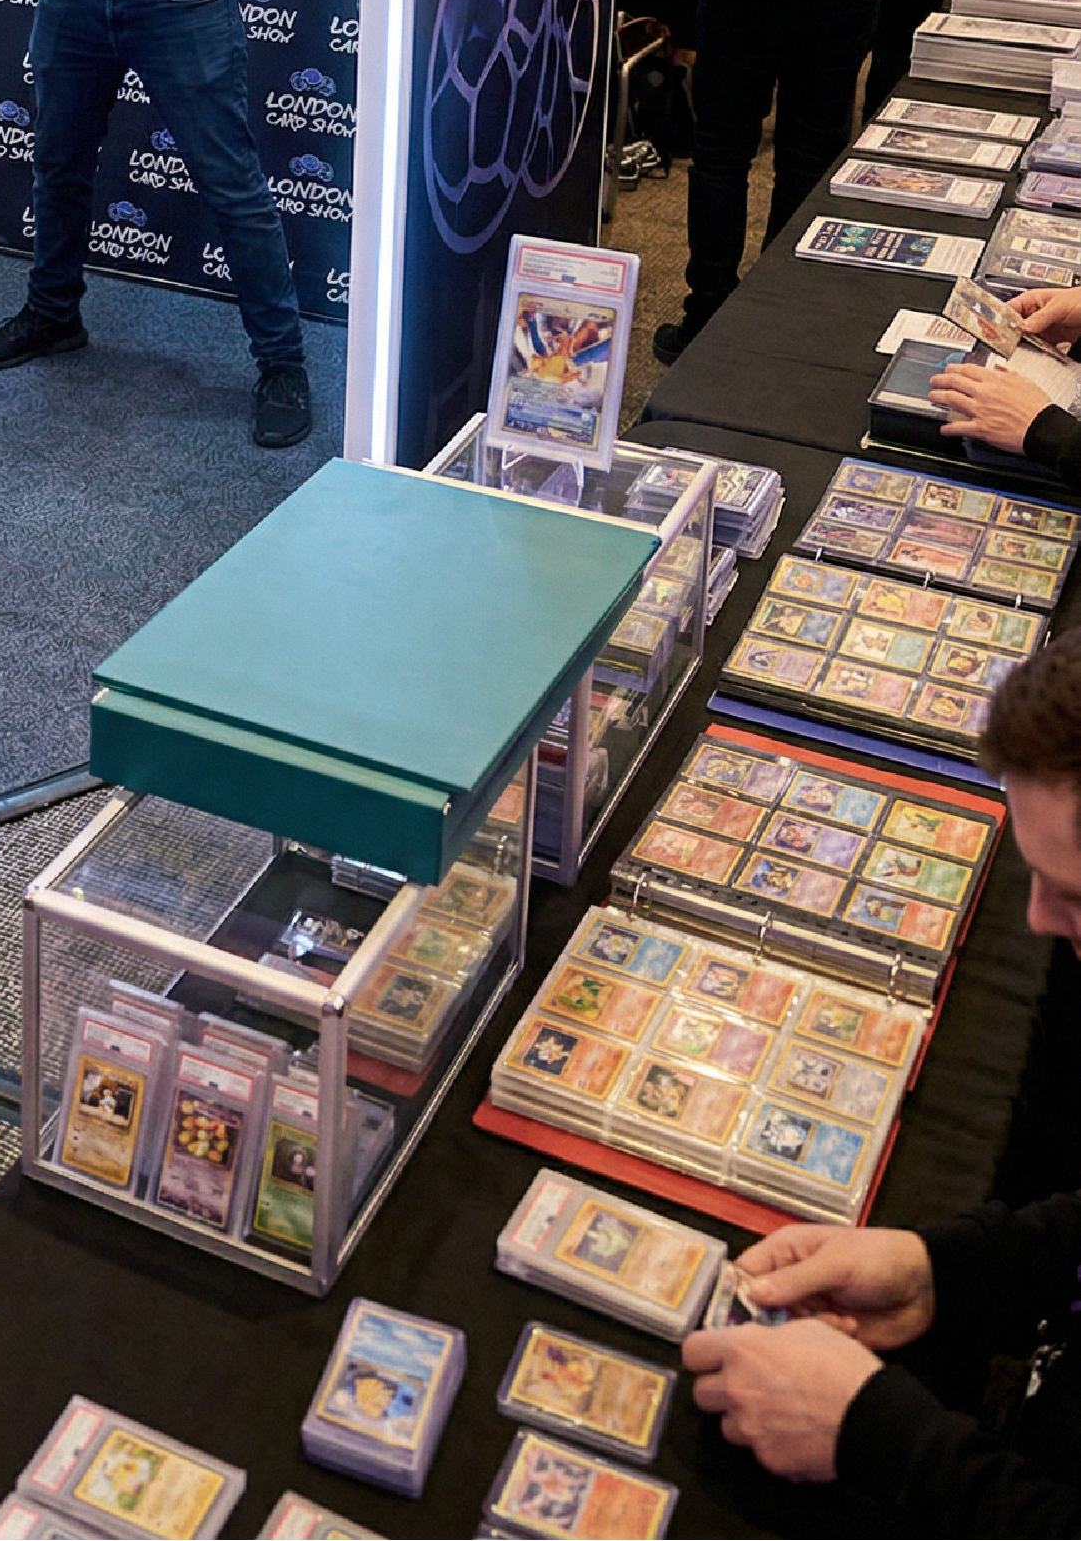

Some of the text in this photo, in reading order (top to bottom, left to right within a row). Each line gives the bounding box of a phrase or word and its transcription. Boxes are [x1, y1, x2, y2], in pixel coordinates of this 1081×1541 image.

[129, 149, 185, 174] LOND
[268, 176, 353, 208] LONDON
[90, 220, 172, 252] LONDON
